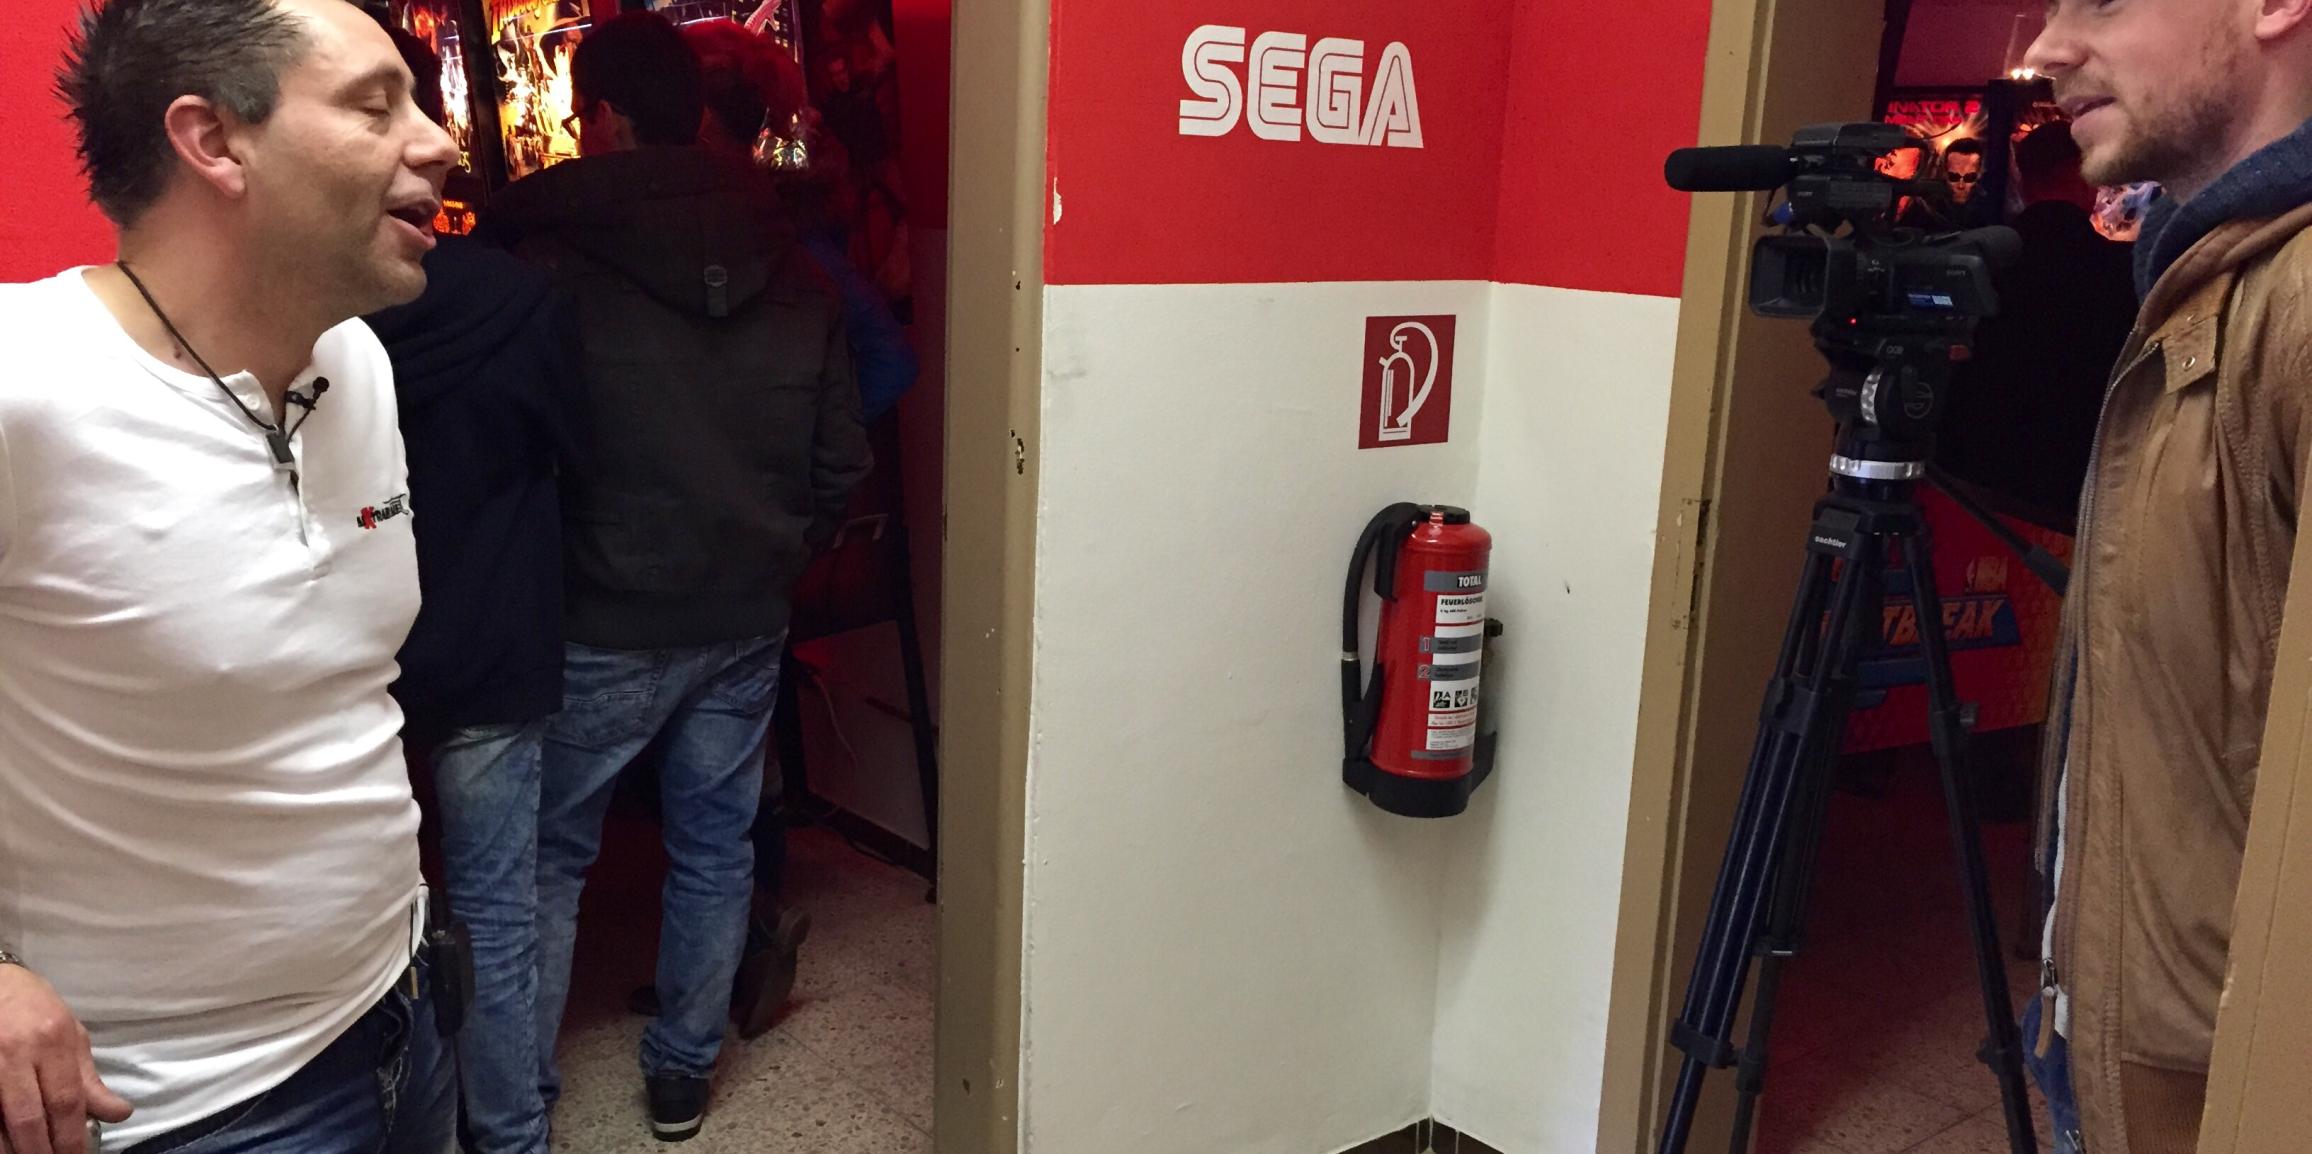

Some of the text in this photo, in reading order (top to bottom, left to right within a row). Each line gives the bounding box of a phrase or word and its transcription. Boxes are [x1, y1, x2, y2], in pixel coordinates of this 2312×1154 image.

[1179, 24, 1424, 148] SEGA
[1887, 100, 1960, 113] INATOR
[1458, 575, 1482, 588] TOTAL
